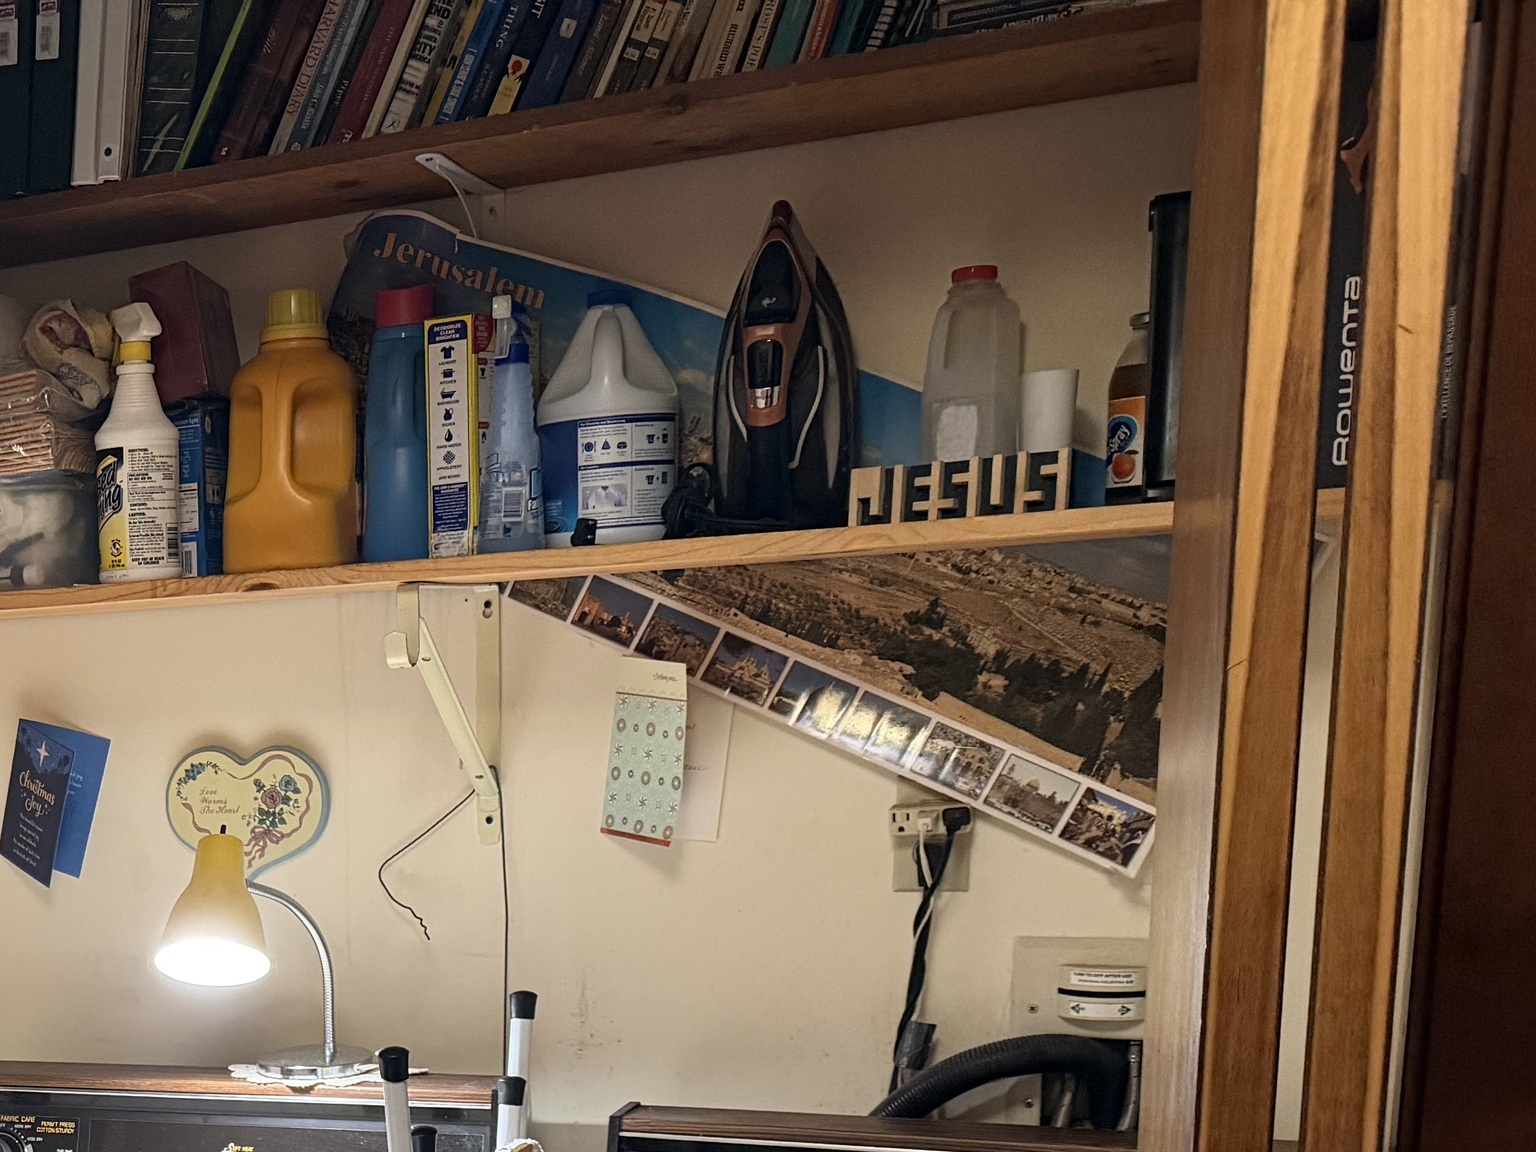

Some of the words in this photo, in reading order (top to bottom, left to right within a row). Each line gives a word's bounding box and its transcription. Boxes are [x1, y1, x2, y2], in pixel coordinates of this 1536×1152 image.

[495, 5, 518, 49] THING
[719, 23, 738, 65] RICHARD
[286, 71, 312, 116] DIARY
[373, 232, 545, 310] Jerusalem
[1109, 423, 1131, 454] Spray
[848, 446, 1073, 527] JESUS
[19, 769, 56, 806] Christmas
[24, 795, 44, 817] Joy
[199, 788, 218, 796] Love
[199, 805, 214, 814] The
[215, 805, 241, 814] Heart
